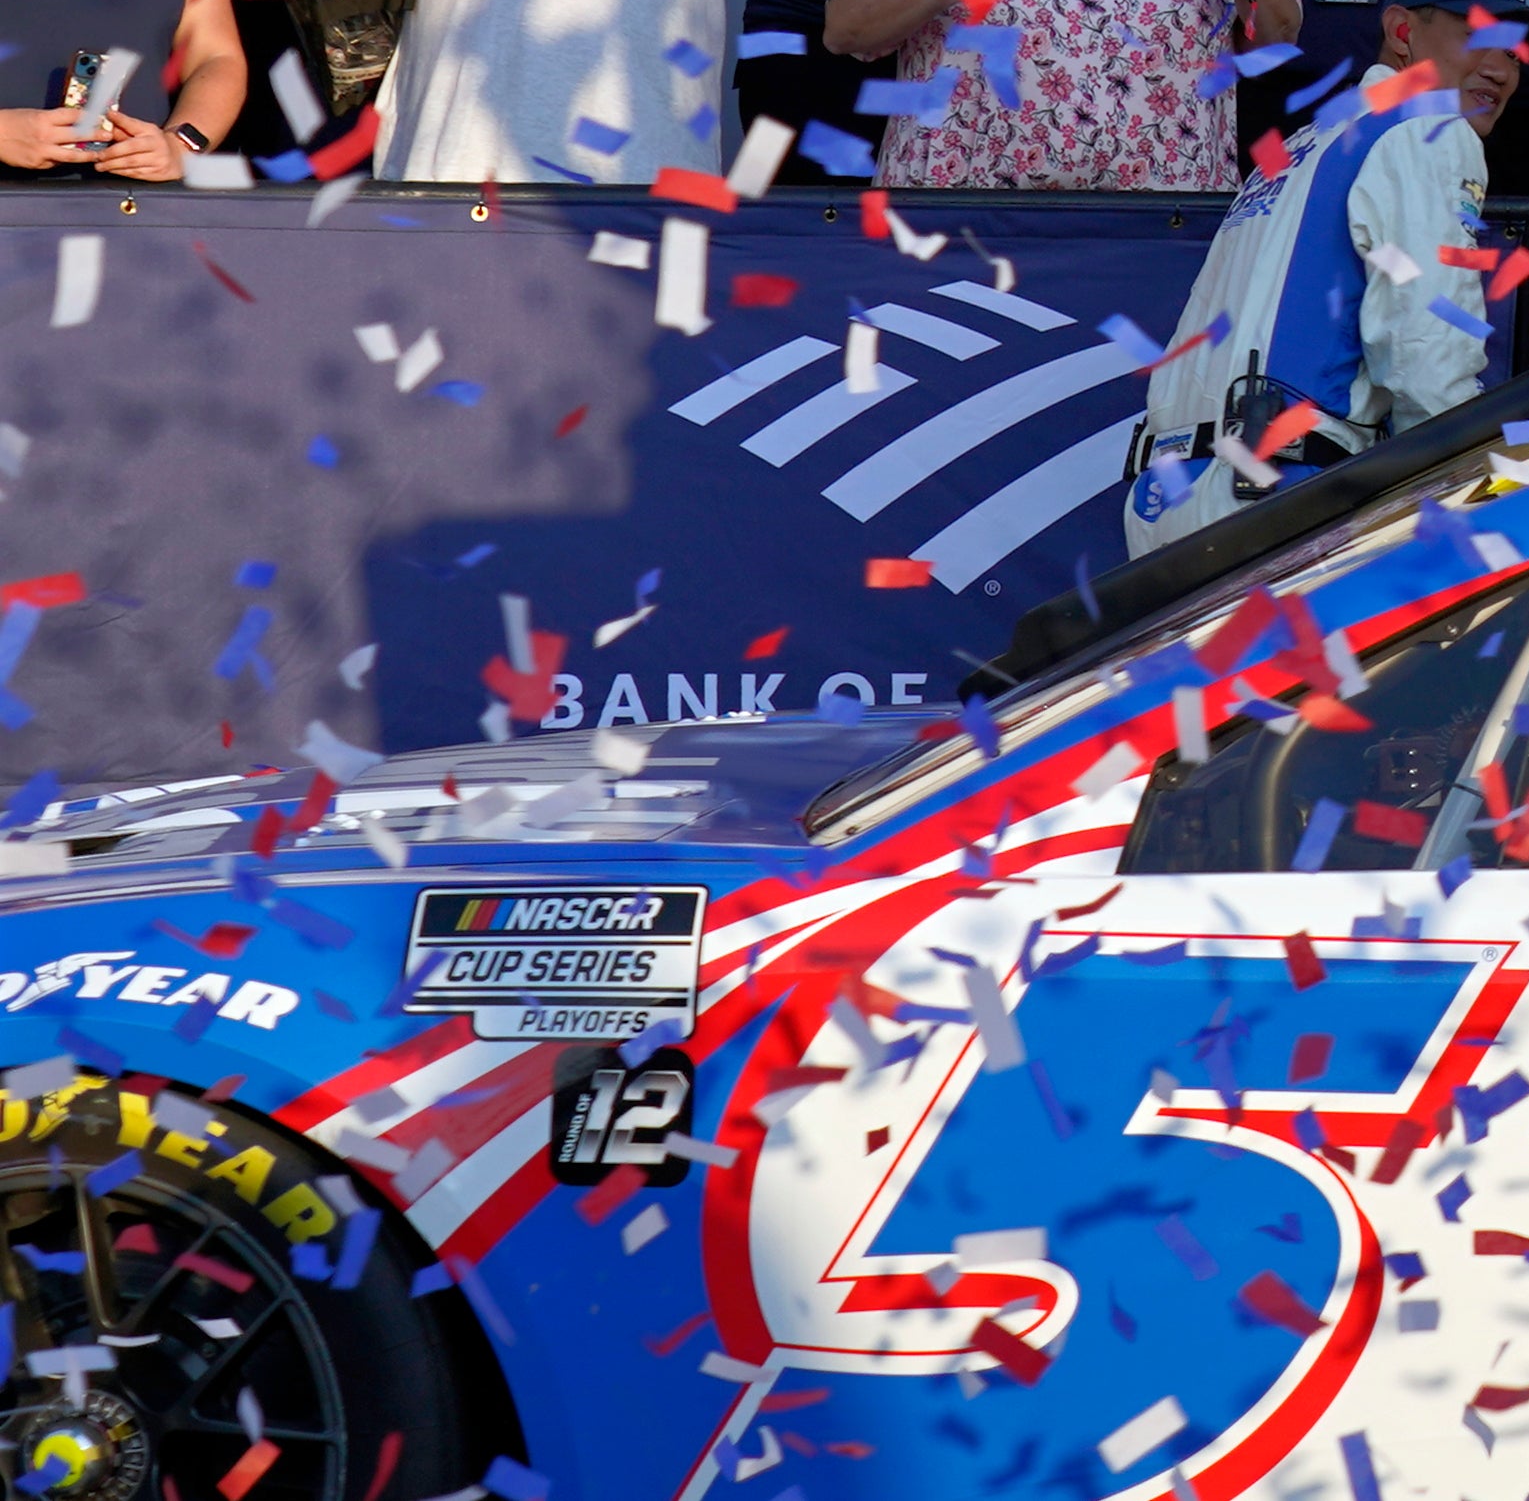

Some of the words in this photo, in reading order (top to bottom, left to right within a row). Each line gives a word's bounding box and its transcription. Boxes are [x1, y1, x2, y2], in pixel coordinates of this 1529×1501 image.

[540, 671, 787, 729] BANK
[503, 897, 664, 931] NASCAR
[446, 949, 524, 983] CUP
[525, 949, 658, 983] SERIES
[517, 1009, 651, 1034] PLAYOFFS
[557, 1114, 587, 1163] ROUND
[575, 1092, 592, 1114] OF
[571, 1069, 691, 1165] 12
